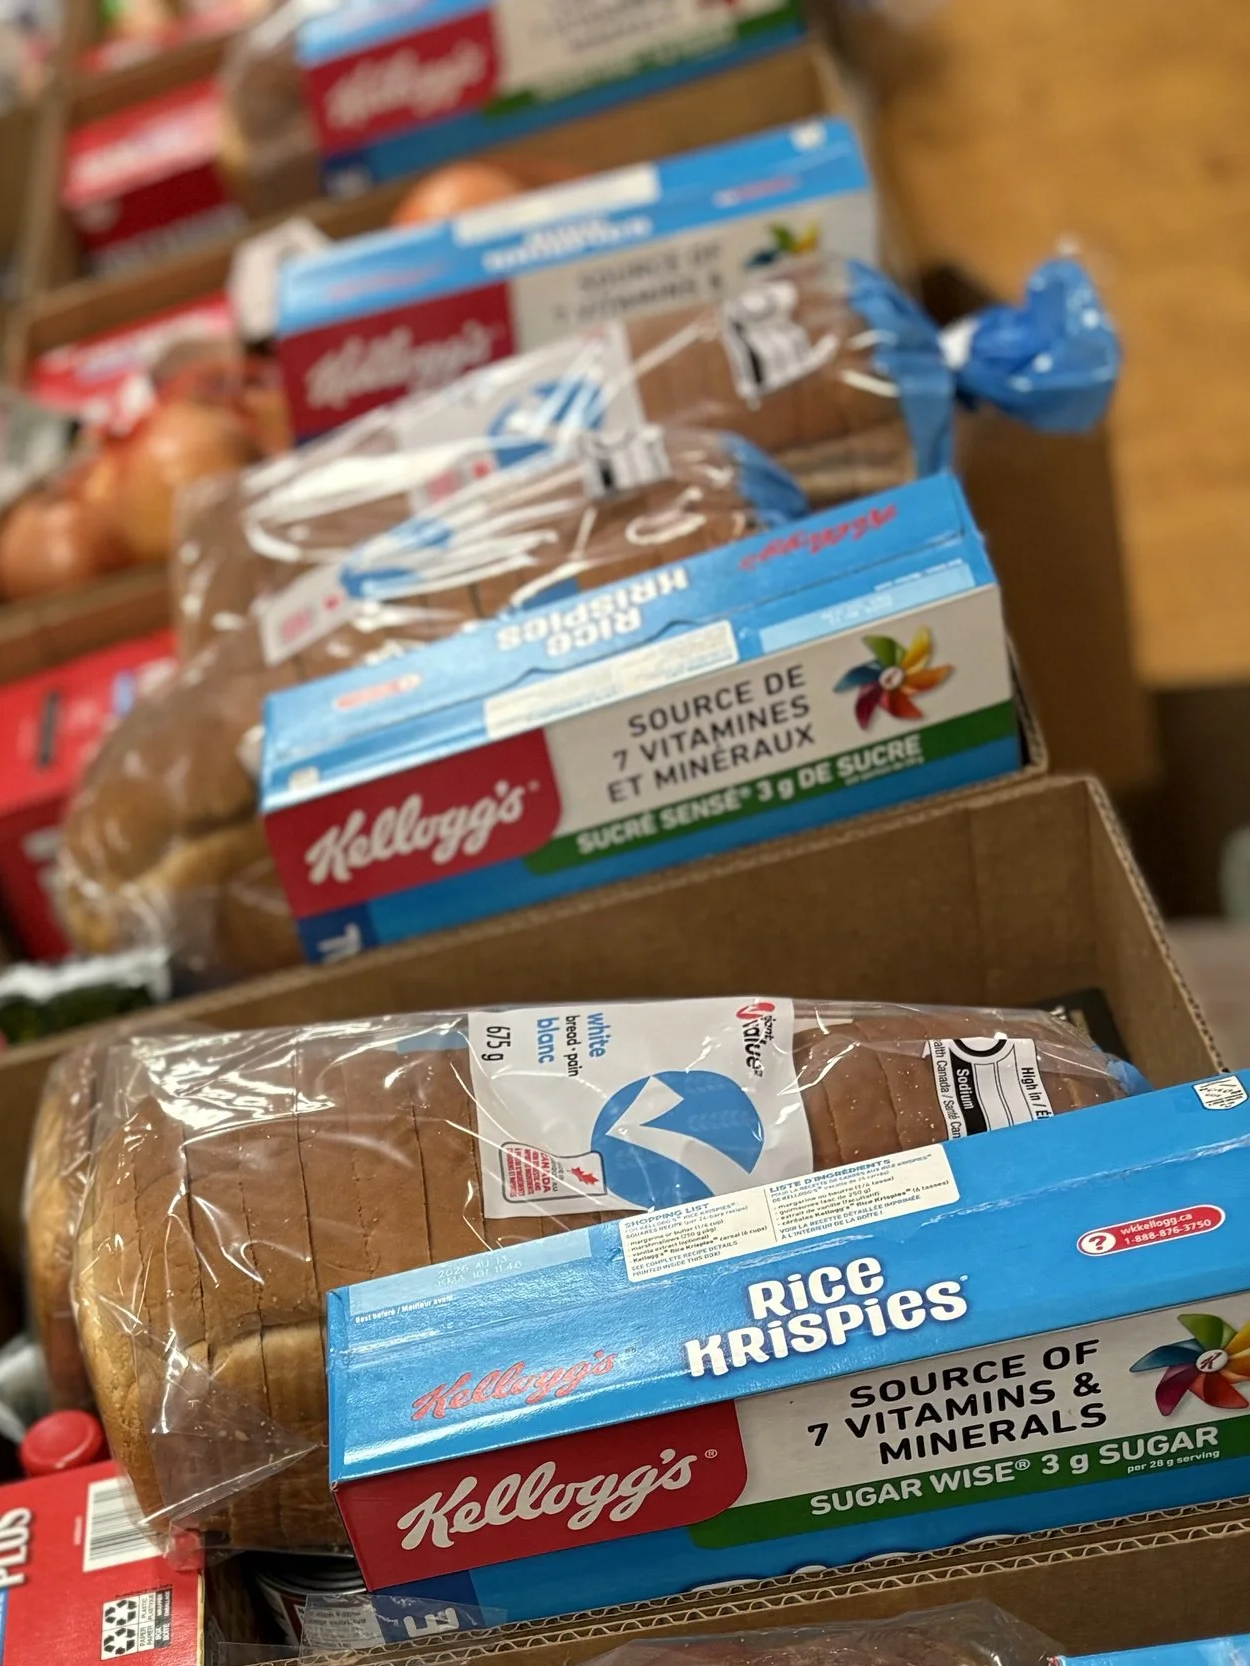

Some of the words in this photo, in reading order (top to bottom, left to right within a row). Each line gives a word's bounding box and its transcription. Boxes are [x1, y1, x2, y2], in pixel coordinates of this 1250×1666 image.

[628, 679, 756, 737] SOURCE
[764, 662, 806, 697] DE
[612, 745, 632, 771] 7
[636, 694, 811, 766] VITAMINES
[607, 774, 648, 804] ET
[653, 723, 816, 795] MINÉRAUX
[756, 780, 773, 803] 3
[777, 777, 795, 800] g
[798, 761, 834, 790] DE
[836, 733, 924, 780] SUCRE
[304, 780, 526, 884] Kellogg's
[485, 1025, 512, 1049] 675
[537, 1016, 561, 1065] blanc
[565, 1014, 581, 1047] bread
[587, 1012, 608, 1059] white
[482, 1051, 498, 1063] g
[566, 1050, 584, 1078] pain
[1021, 1067, 1039, 1092] High
[937, 1059, 950, 1097] Canada
[944, 1100, 957, 1121] Santé
[956, 1068, 976, 1111] Sodium
[624, 1210, 683, 1229] SHOPPING
[684, 1203, 710, 1215] LIST
[1120, 1213, 1194, 1236] wkkellogg.ca
[1124, 1219, 1213, 1246] 1-888-876-3750
[437, 1264, 469, 1279] 2026
[355, 1313, 372, 1323] Best
[373, 1308, 397, 1320] before
[410, 1348, 616, 1423] Kellogg's
[850, 1354, 1032, 1409] SOURCE
[1043, 1338, 1101, 1371] OF
[807, 1422, 829, 1448] 7
[844, 1378, 1057, 1441] VITAMINS
[1074, 1370, 1103, 1397] &
[878, 1402, 1109, 1465] MINERALS
[810, 1476, 922, 1517] SUGAR
[1041, 1452, 1061, 1479] 3
[1069, 1452, 1090, 1475] g
[1098, 1425, 1220, 1466] SUGAR
[1127, 1463, 1148, 1475] per
[1149, 1459, 1165, 1469] 28
[1166, 1458, 1175, 1468] g
[1175, 1450, 1221, 1465] serving
[397, 1446, 698, 1552] Kellogg's
